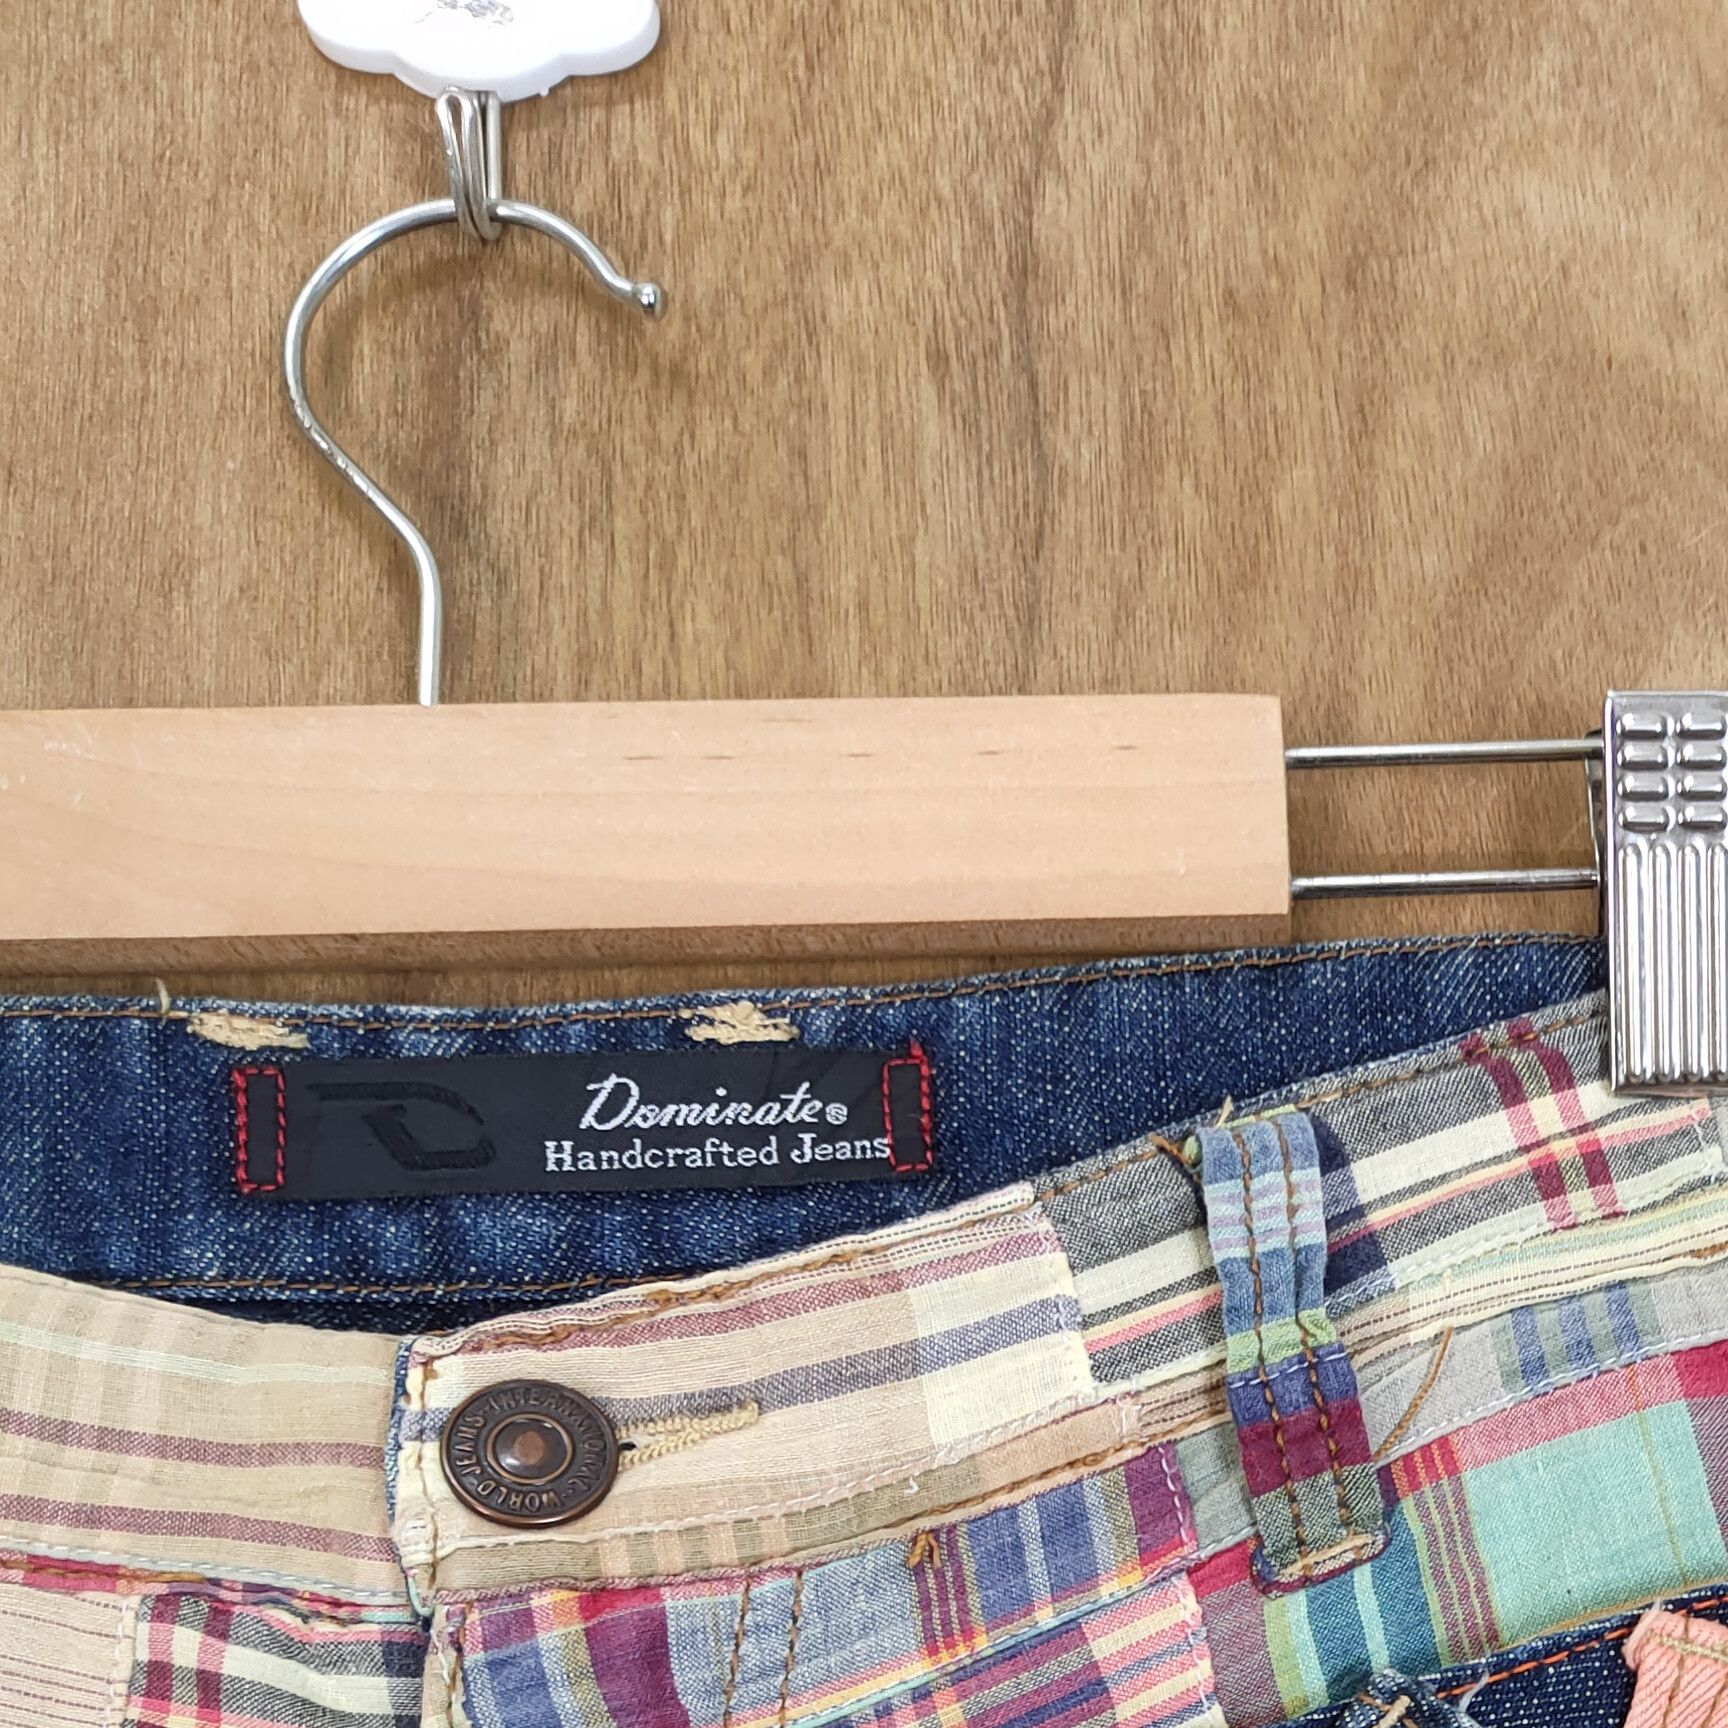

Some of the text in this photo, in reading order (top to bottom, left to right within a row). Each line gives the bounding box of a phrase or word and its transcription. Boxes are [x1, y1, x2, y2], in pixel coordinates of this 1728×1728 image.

[544, 1133, 890, 1171] Handcrafted Jeans
[453, 1415, 486, 1476] JEANS
[476, 1480, 563, 1513] WORLD
